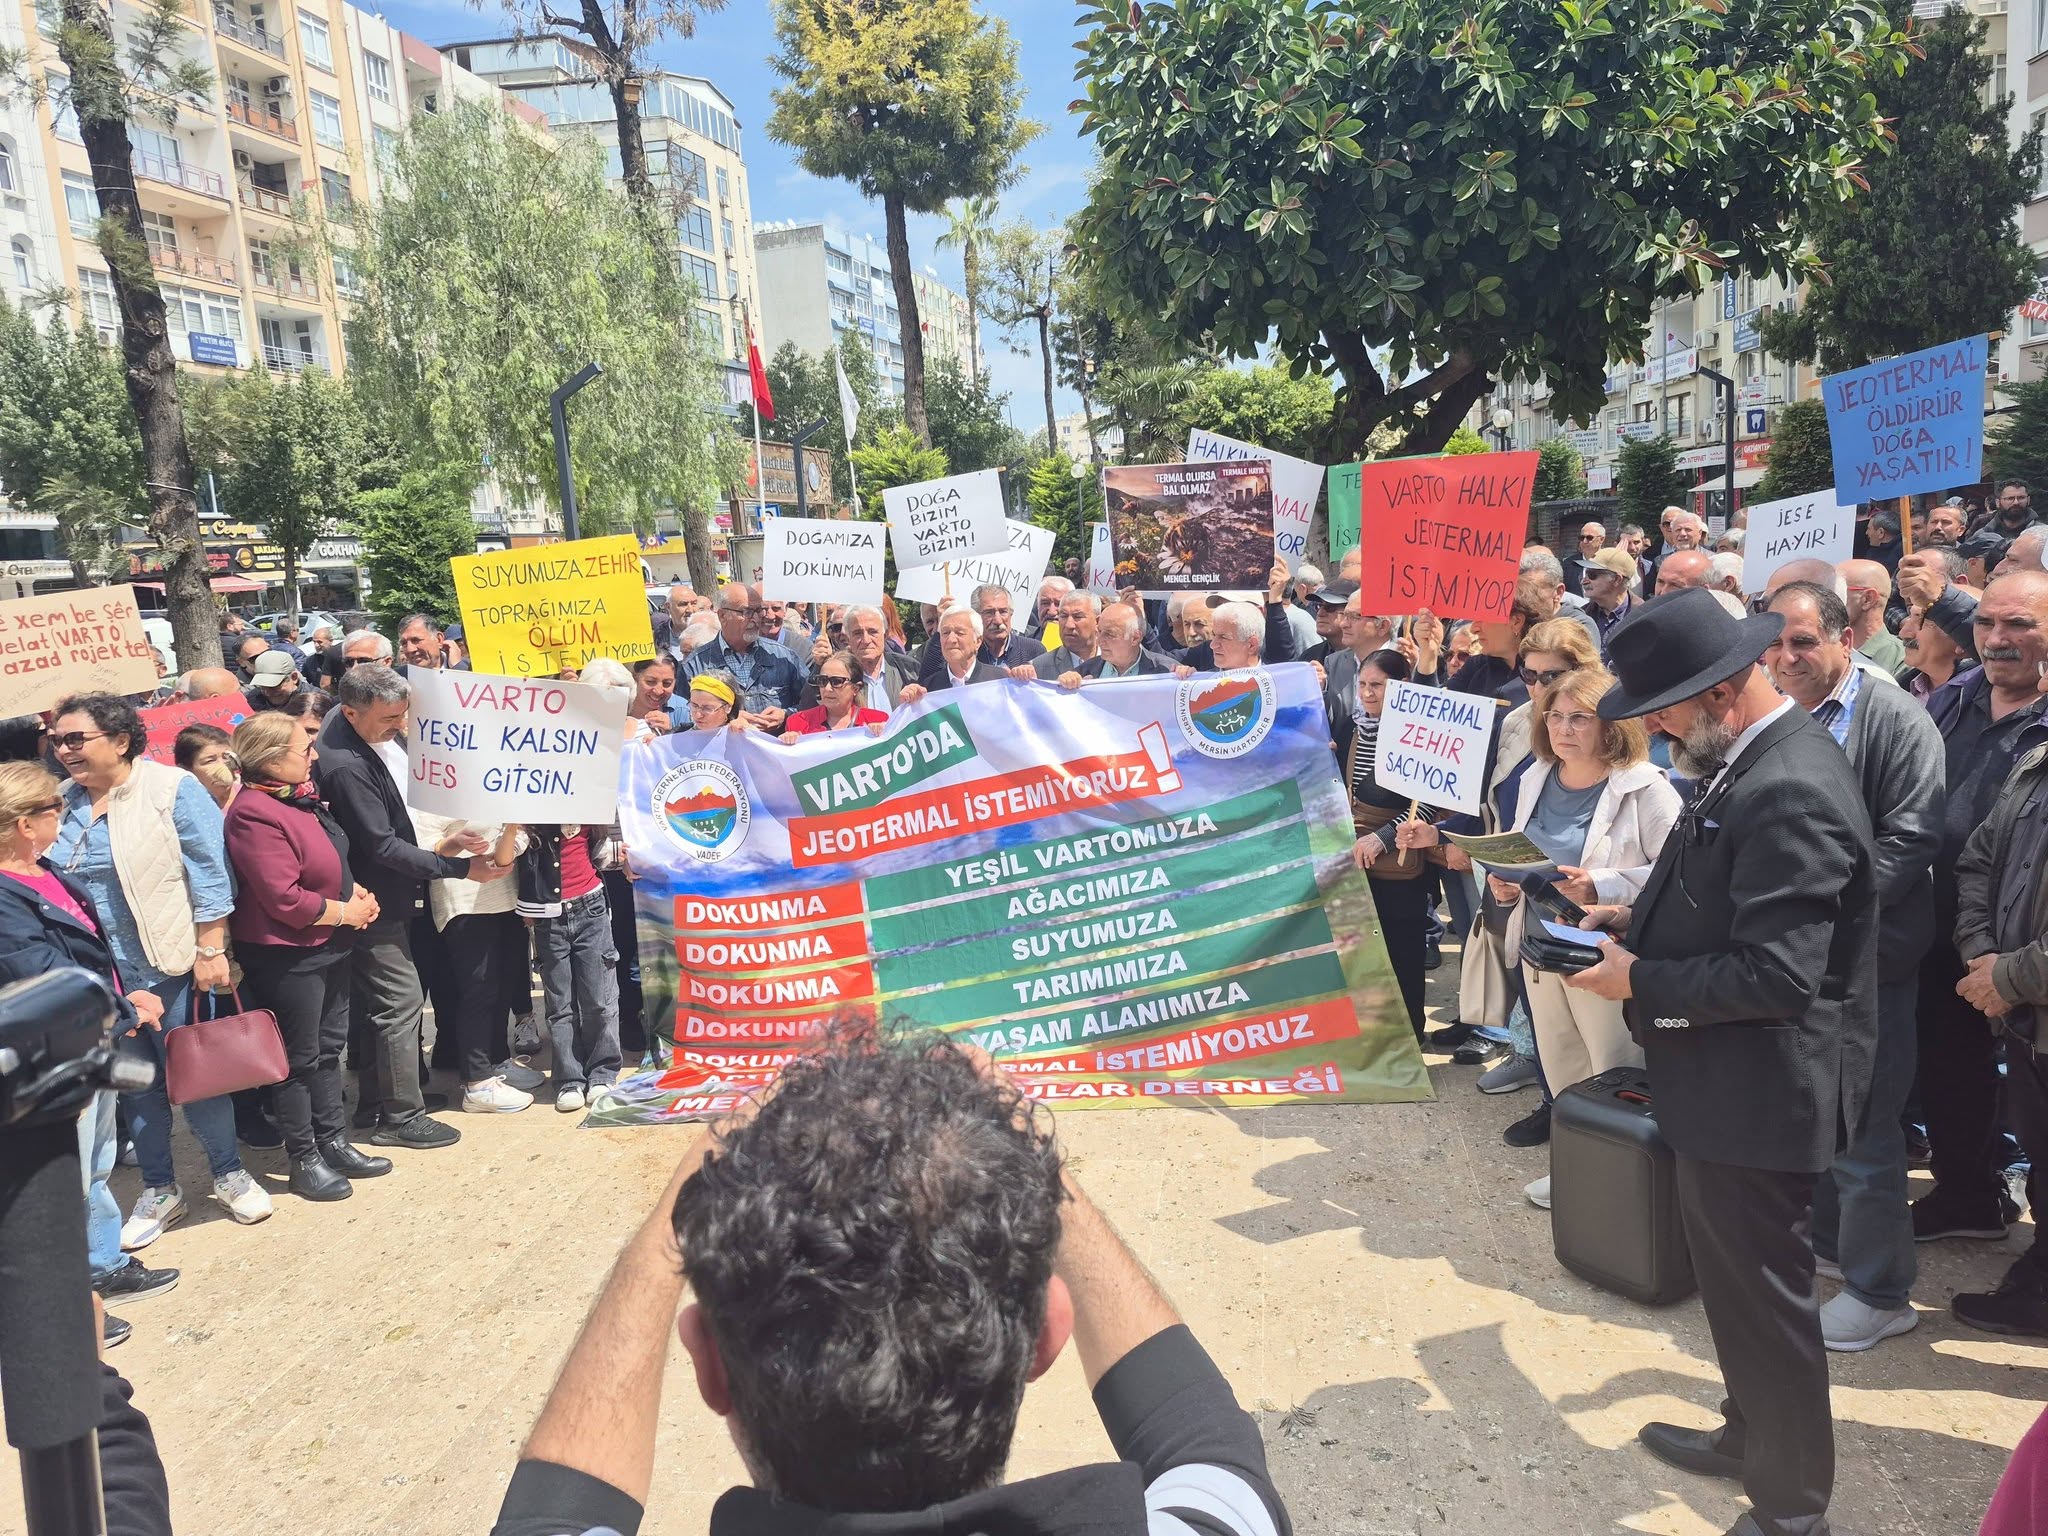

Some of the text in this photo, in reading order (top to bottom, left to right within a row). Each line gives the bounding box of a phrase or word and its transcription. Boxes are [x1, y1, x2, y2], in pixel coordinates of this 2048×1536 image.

[1838, 345, 1981, 413] JEOTERMAL
[1867, 386, 1964, 432] ÖLDÜRÜR
[1872, 427, 1936, 455] DOĞA
[1155, 470, 1217, 484] TERMAL OLURSA
[1163, 482, 1211, 496] BAL OLMAZ
[1222, 467, 1265, 477] TERMALE HAYIR
[906, 488, 962, 513] DOĞA
[1382, 474, 1446, 509] VARTO
[1458, 475, 1526, 508] HALKI
[910, 505, 958, 527] BİZİM
[913, 518, 972, 542] VARTO
[786, 529, 874, 549] DOĞAMIZA
[472, 548, 641, 589] SUYUMUZA ZEHİR
[1163, 572, 1221, 585] MENGEL GENÇLİK
[14, 611, 68, 630] xem
[69, 603, 97, 624] be
[472, 597, 607, 628] TOPRAĞIMIZA
[0, 632, 51, 656] elat
[528, 617, 601, 648] ÖLÜM
[3, 650, 62, 676] azad
[70, 643, 123, 665] rojek
[498, 640, 656, 676] İSTEMİYORUZ
[454, 681, 567, 715] VARTO
[1390, 684, 1483, 731] JEOTERMAL
[417, 717, 599, 755] YEŞİL KALSIN
[1199, 716, 1271, 755] MERSİN VARTO-DER
[1399, 723, 1465, 765] ZEHİR
[412, 754, 575, 796] JES GİTSİN.
[1385, 752, 1461, 800] SAÇIYOR.
[653, 762, 707, 802] DERNEKLERİ
[709, 763, 749, 824] FEDERASYONU
[802, 803, 960, 858] JEOTERMAL
[686, 812, 1218, 924] DOKUNMA YEŞİL VARTOMUZA
[696, 850, 721, 860] VADEF
[686, 866, 1170, 966] DOKUNMA AĞACIMIZA
[690, 908, 1178, 1005] DOKUNMA SUYUMUZA
[1013, 950, 1188, 1004] TARIMIMIZA
[684, 981, 1250, 1068] DOKUN YAŞAM ALANIMIZA
[1096, 1014, 1314, 1072] İSTEMİYORUZ
[1144, 1066, 1341, 1097] DERNEĞİ
